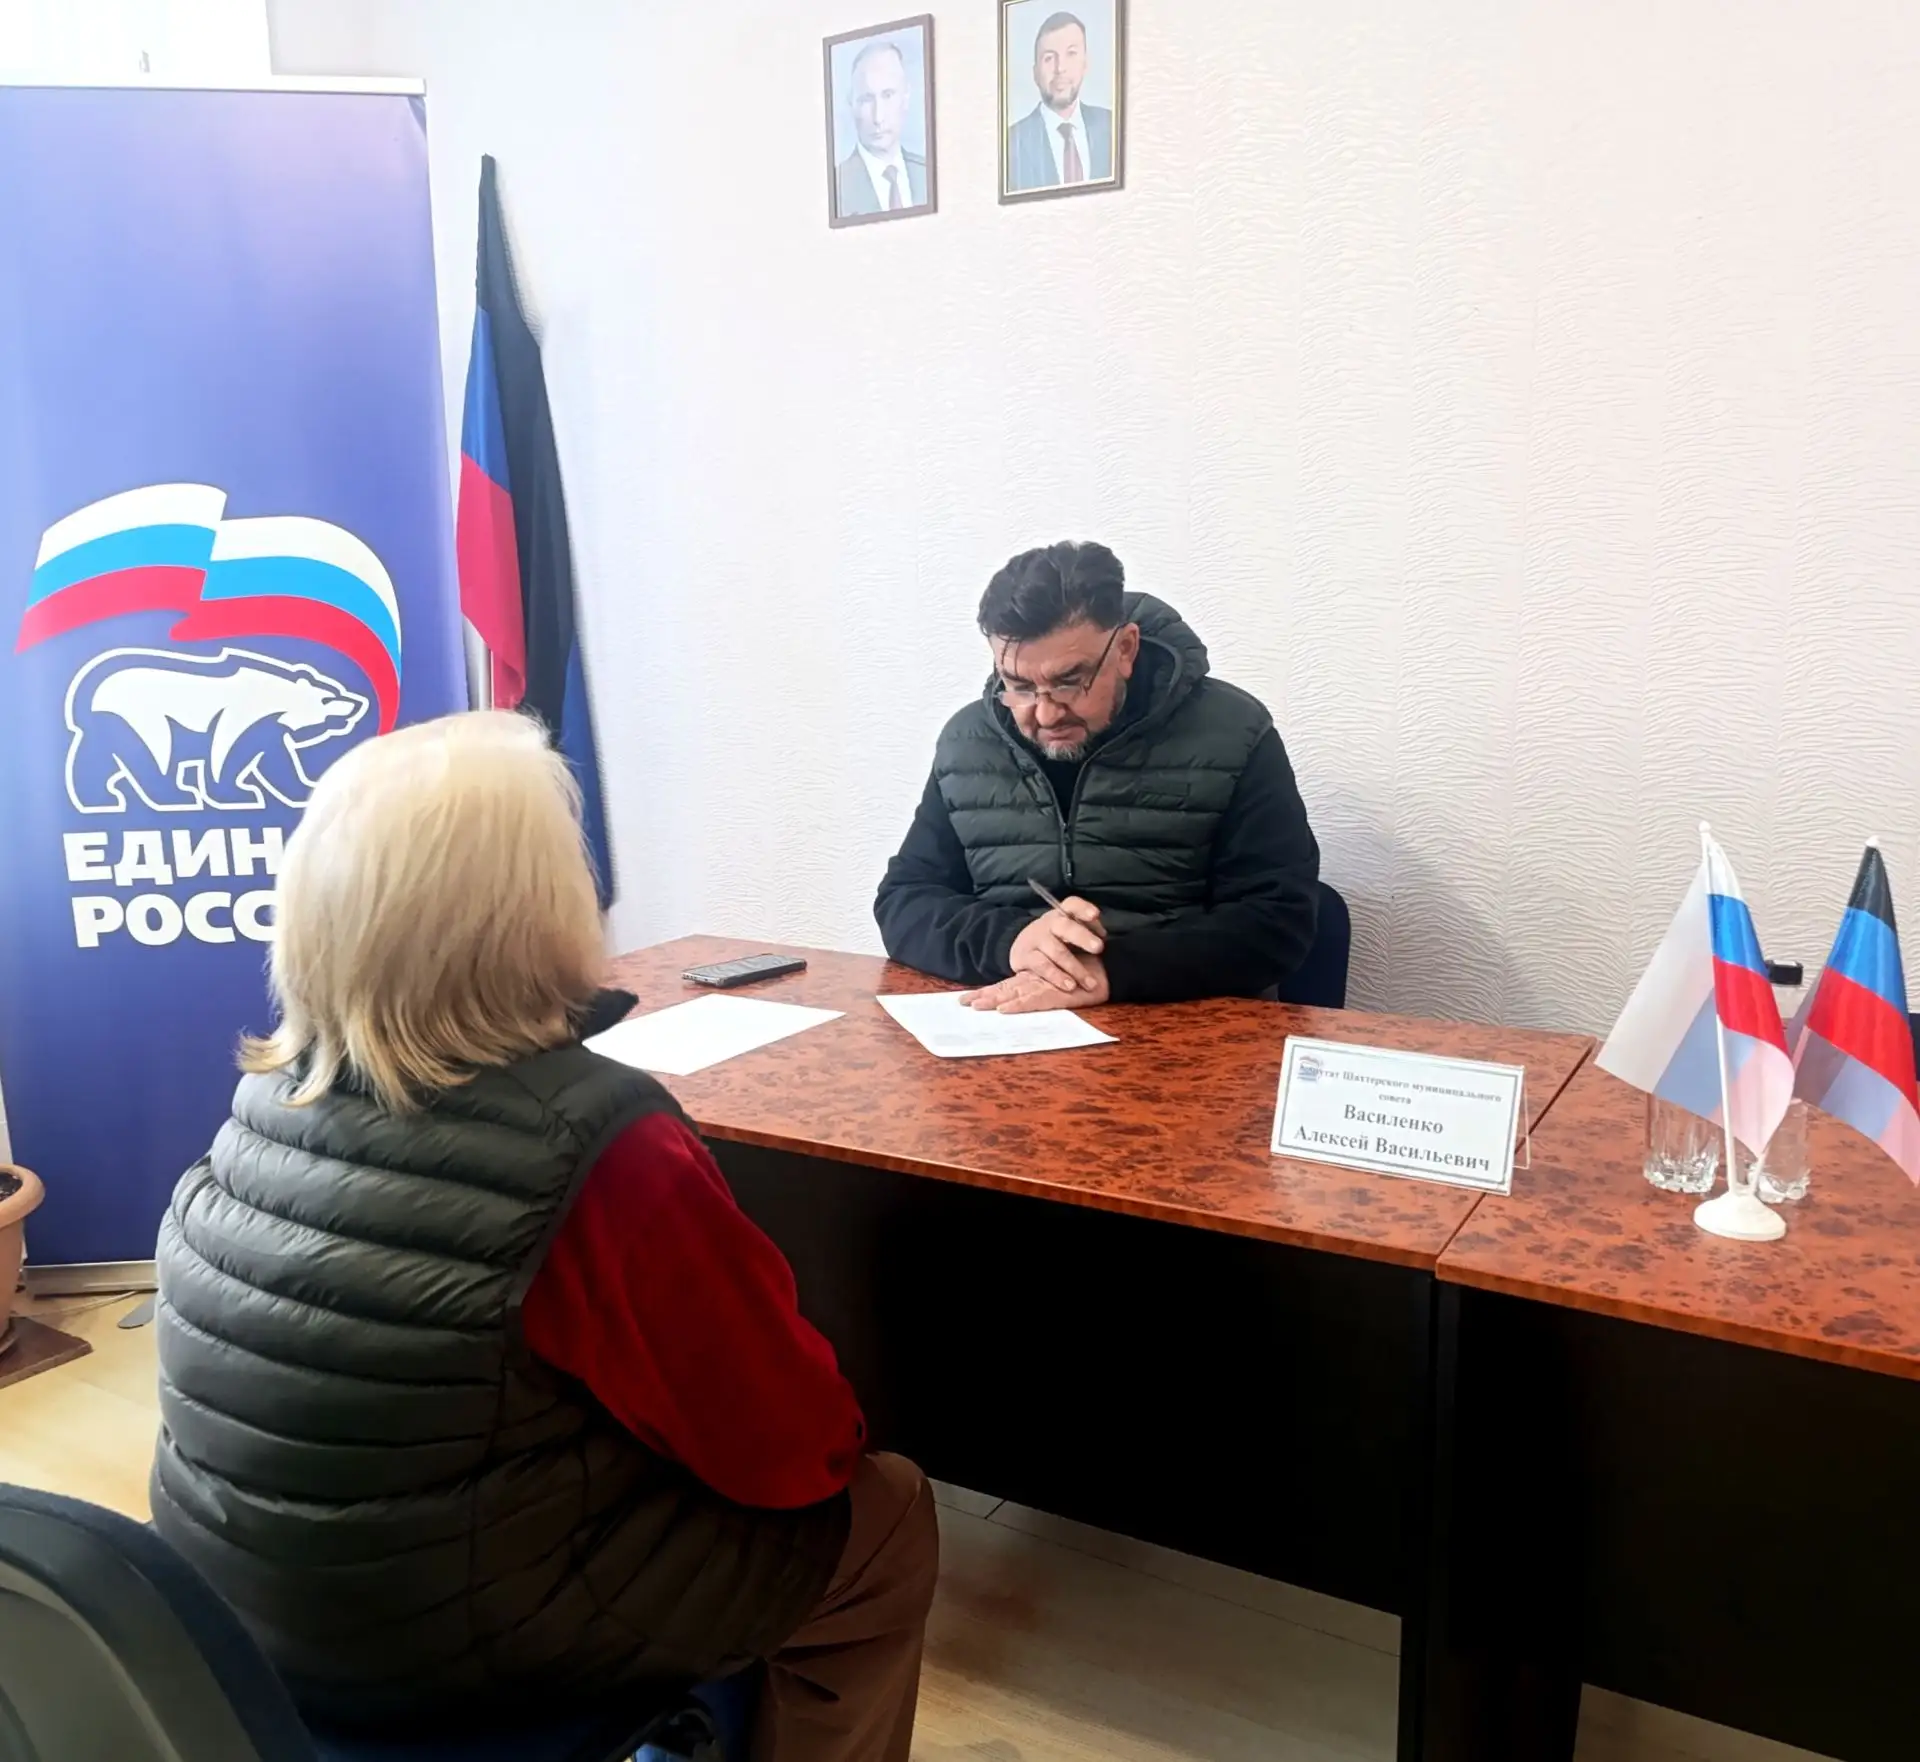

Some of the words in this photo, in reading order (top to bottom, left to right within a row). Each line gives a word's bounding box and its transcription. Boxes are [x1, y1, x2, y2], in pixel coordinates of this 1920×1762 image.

[63, 827, 284, 886] ЕДИН
[1299, 1063, 1339, 1081] утат
[1378, 1093, 1412, 1105] совета
[1343, 1103, 1444, 1135] Василенко
[1294, 1125, 1369, 1151] Алексей
[1375, 1137, 1491, 1172] Васильевич
